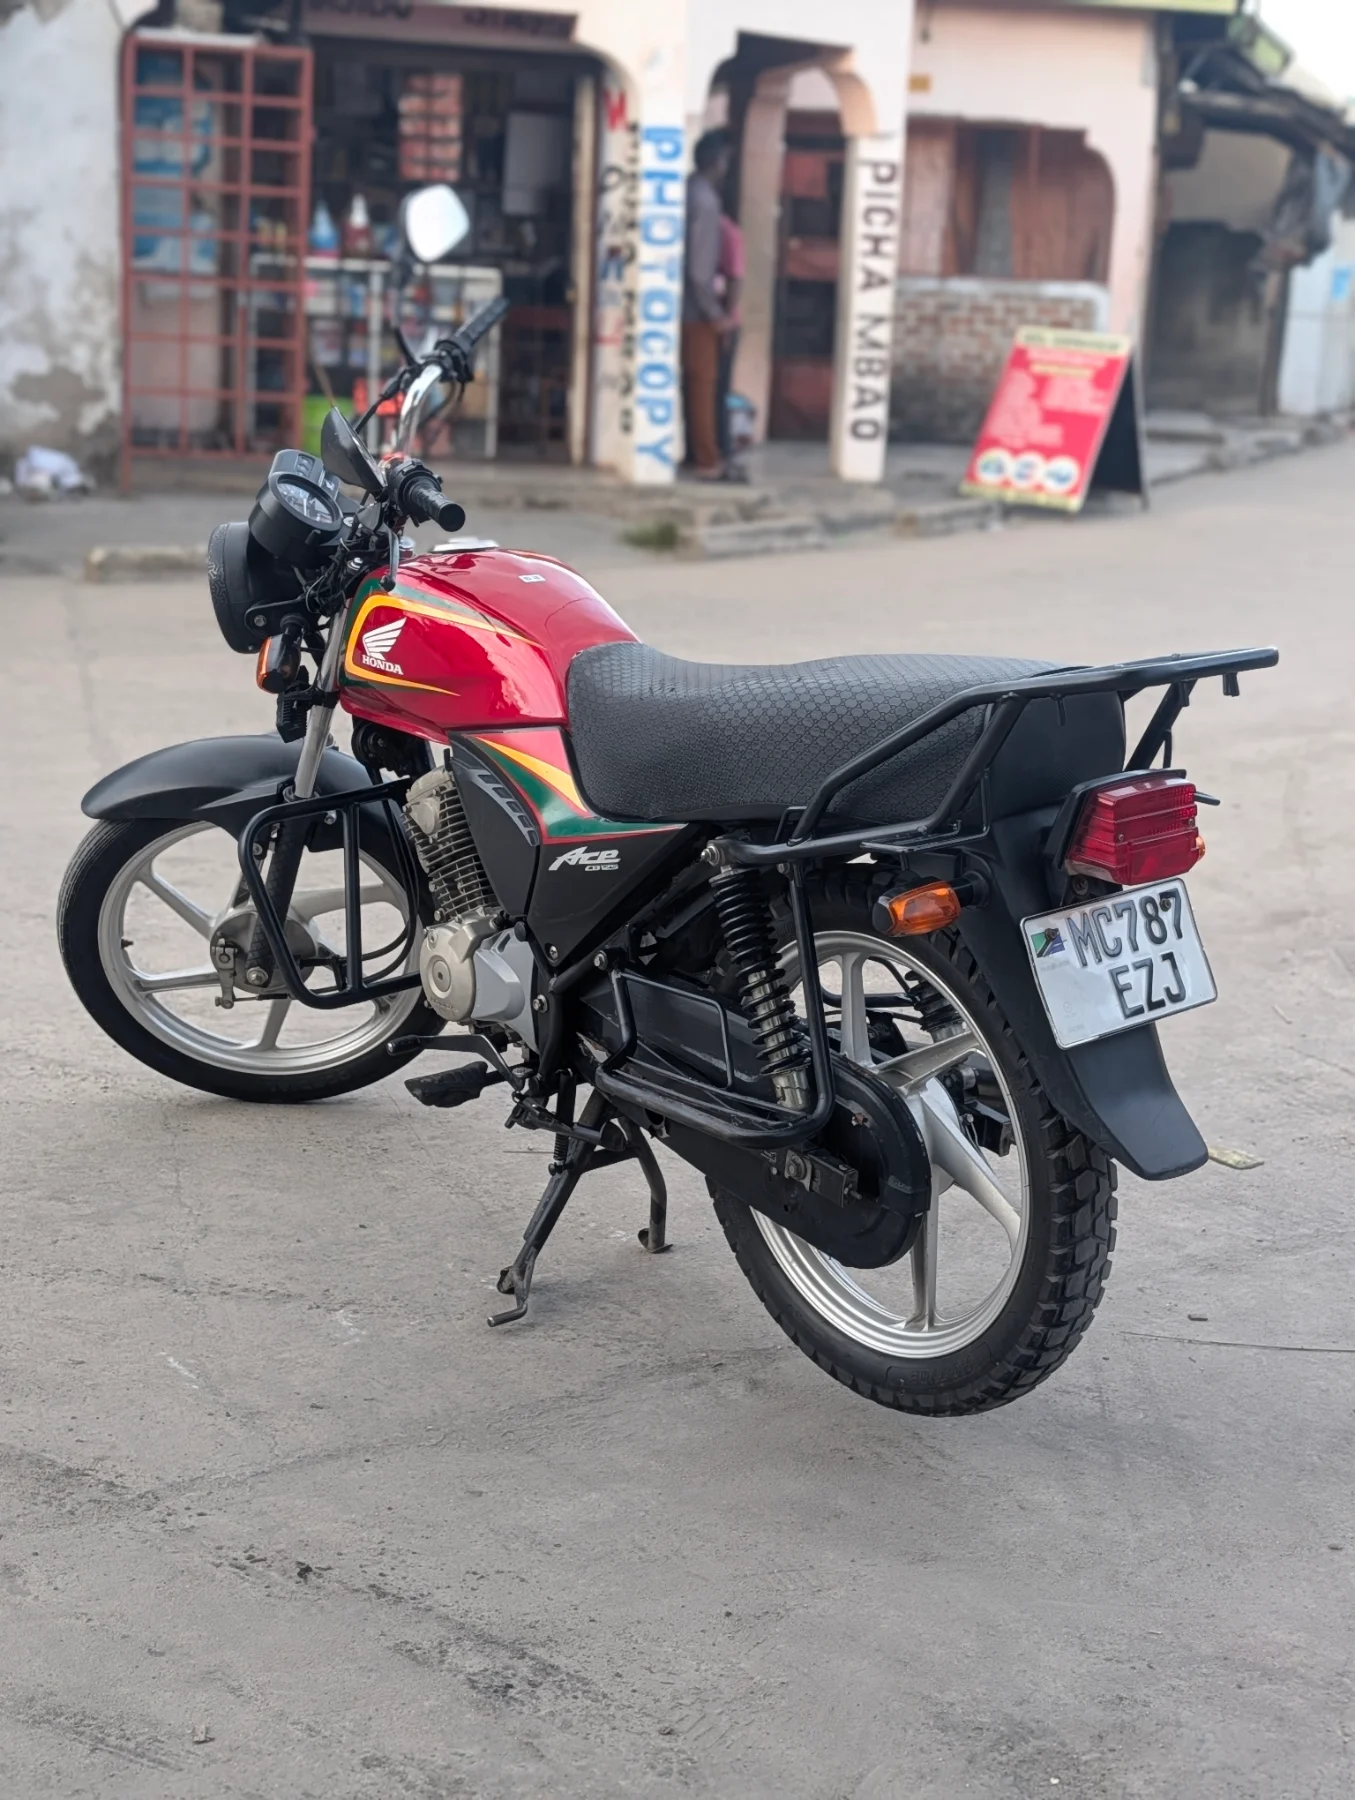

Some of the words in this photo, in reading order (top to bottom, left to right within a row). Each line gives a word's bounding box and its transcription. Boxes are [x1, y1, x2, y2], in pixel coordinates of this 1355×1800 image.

[860, 161, 897, 292] PICHA
[636, 125, 684, 471] PHOTOCOPY
[849, 313, 890, 441] MBAO
[362, 654, 404, 676] HONDA
[548, 845, 621, 871] Ace
[1066, 887, 1184, 968] MC787
[1108, 951, 1187, 1020] EZJ
